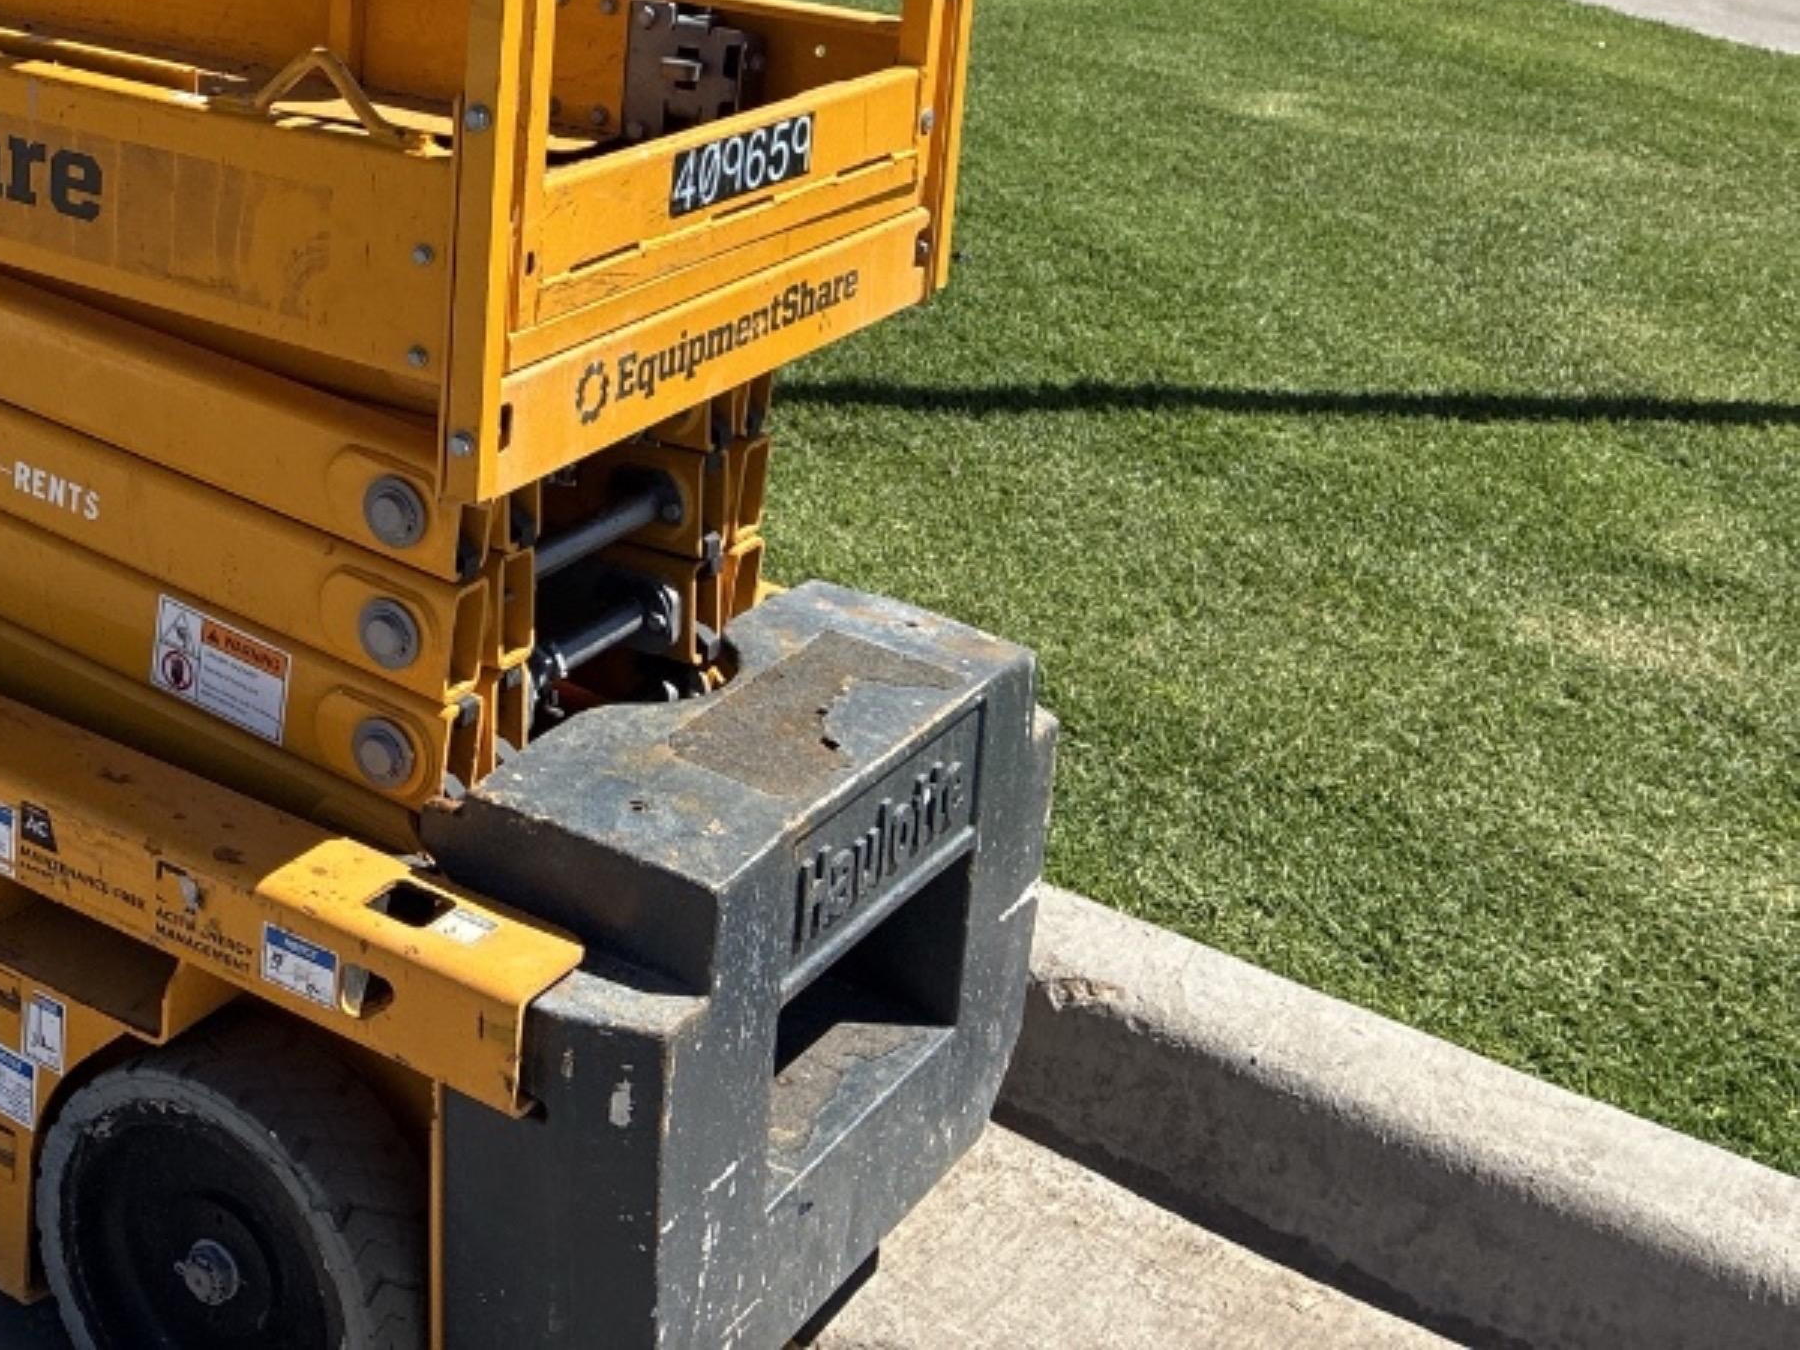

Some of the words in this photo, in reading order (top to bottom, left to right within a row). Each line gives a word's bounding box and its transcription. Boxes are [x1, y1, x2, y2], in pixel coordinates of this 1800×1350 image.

[673, 115, 812, 210] 409659
[614, 269, 859, 400] EquipmentShare
[797, 762, 965, 943] Haulotte
[155, 922, 250, 973] MANAGEMENT
